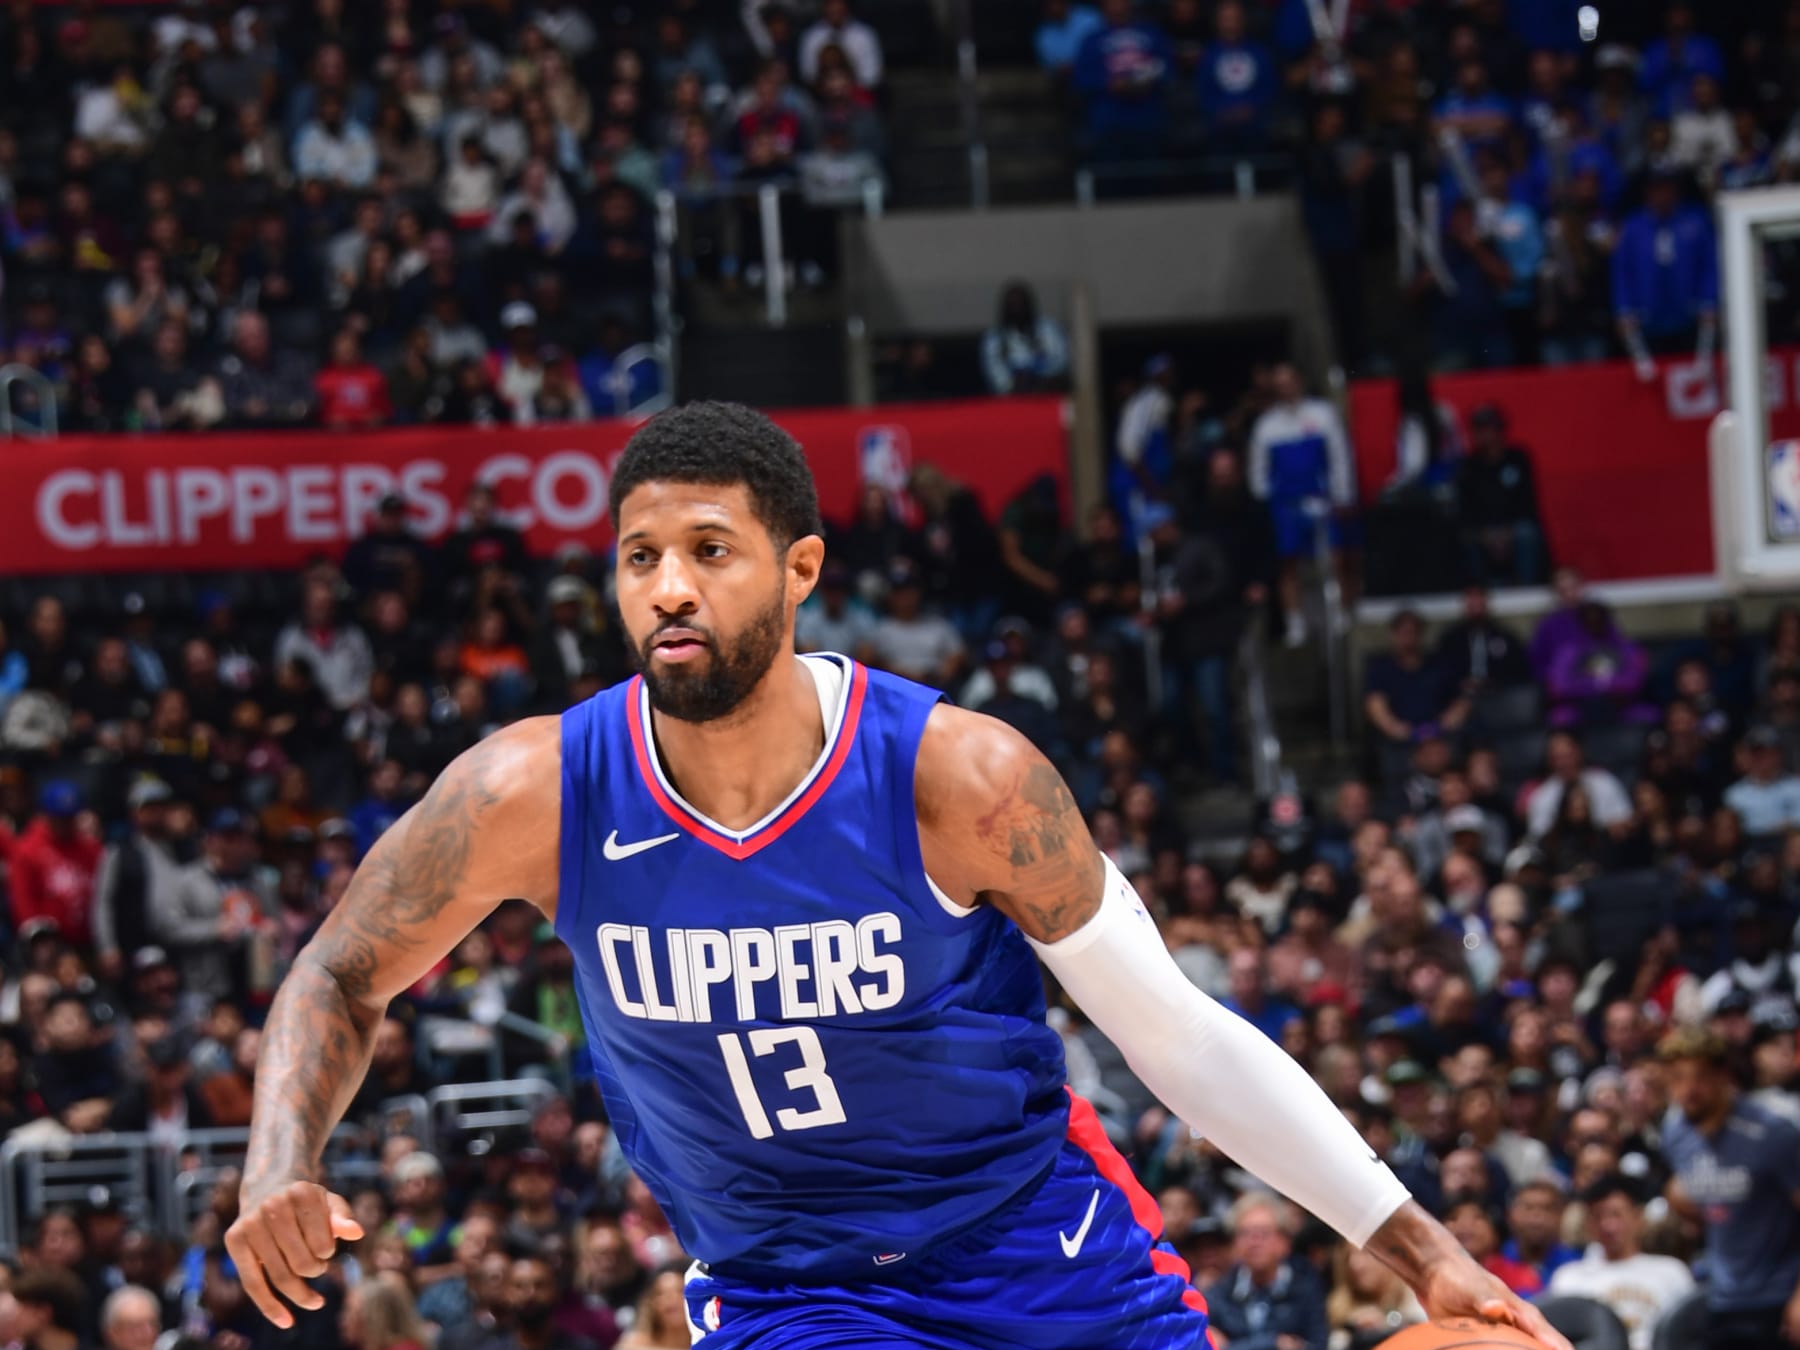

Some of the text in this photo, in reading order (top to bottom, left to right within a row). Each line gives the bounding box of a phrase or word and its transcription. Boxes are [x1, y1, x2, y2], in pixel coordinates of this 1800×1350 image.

[37, 453, 622, 548] CLIPPERS.CO
[597, 911, 905, 1023] CLIPPERS
[717, 1026, 847, 1140] 13
